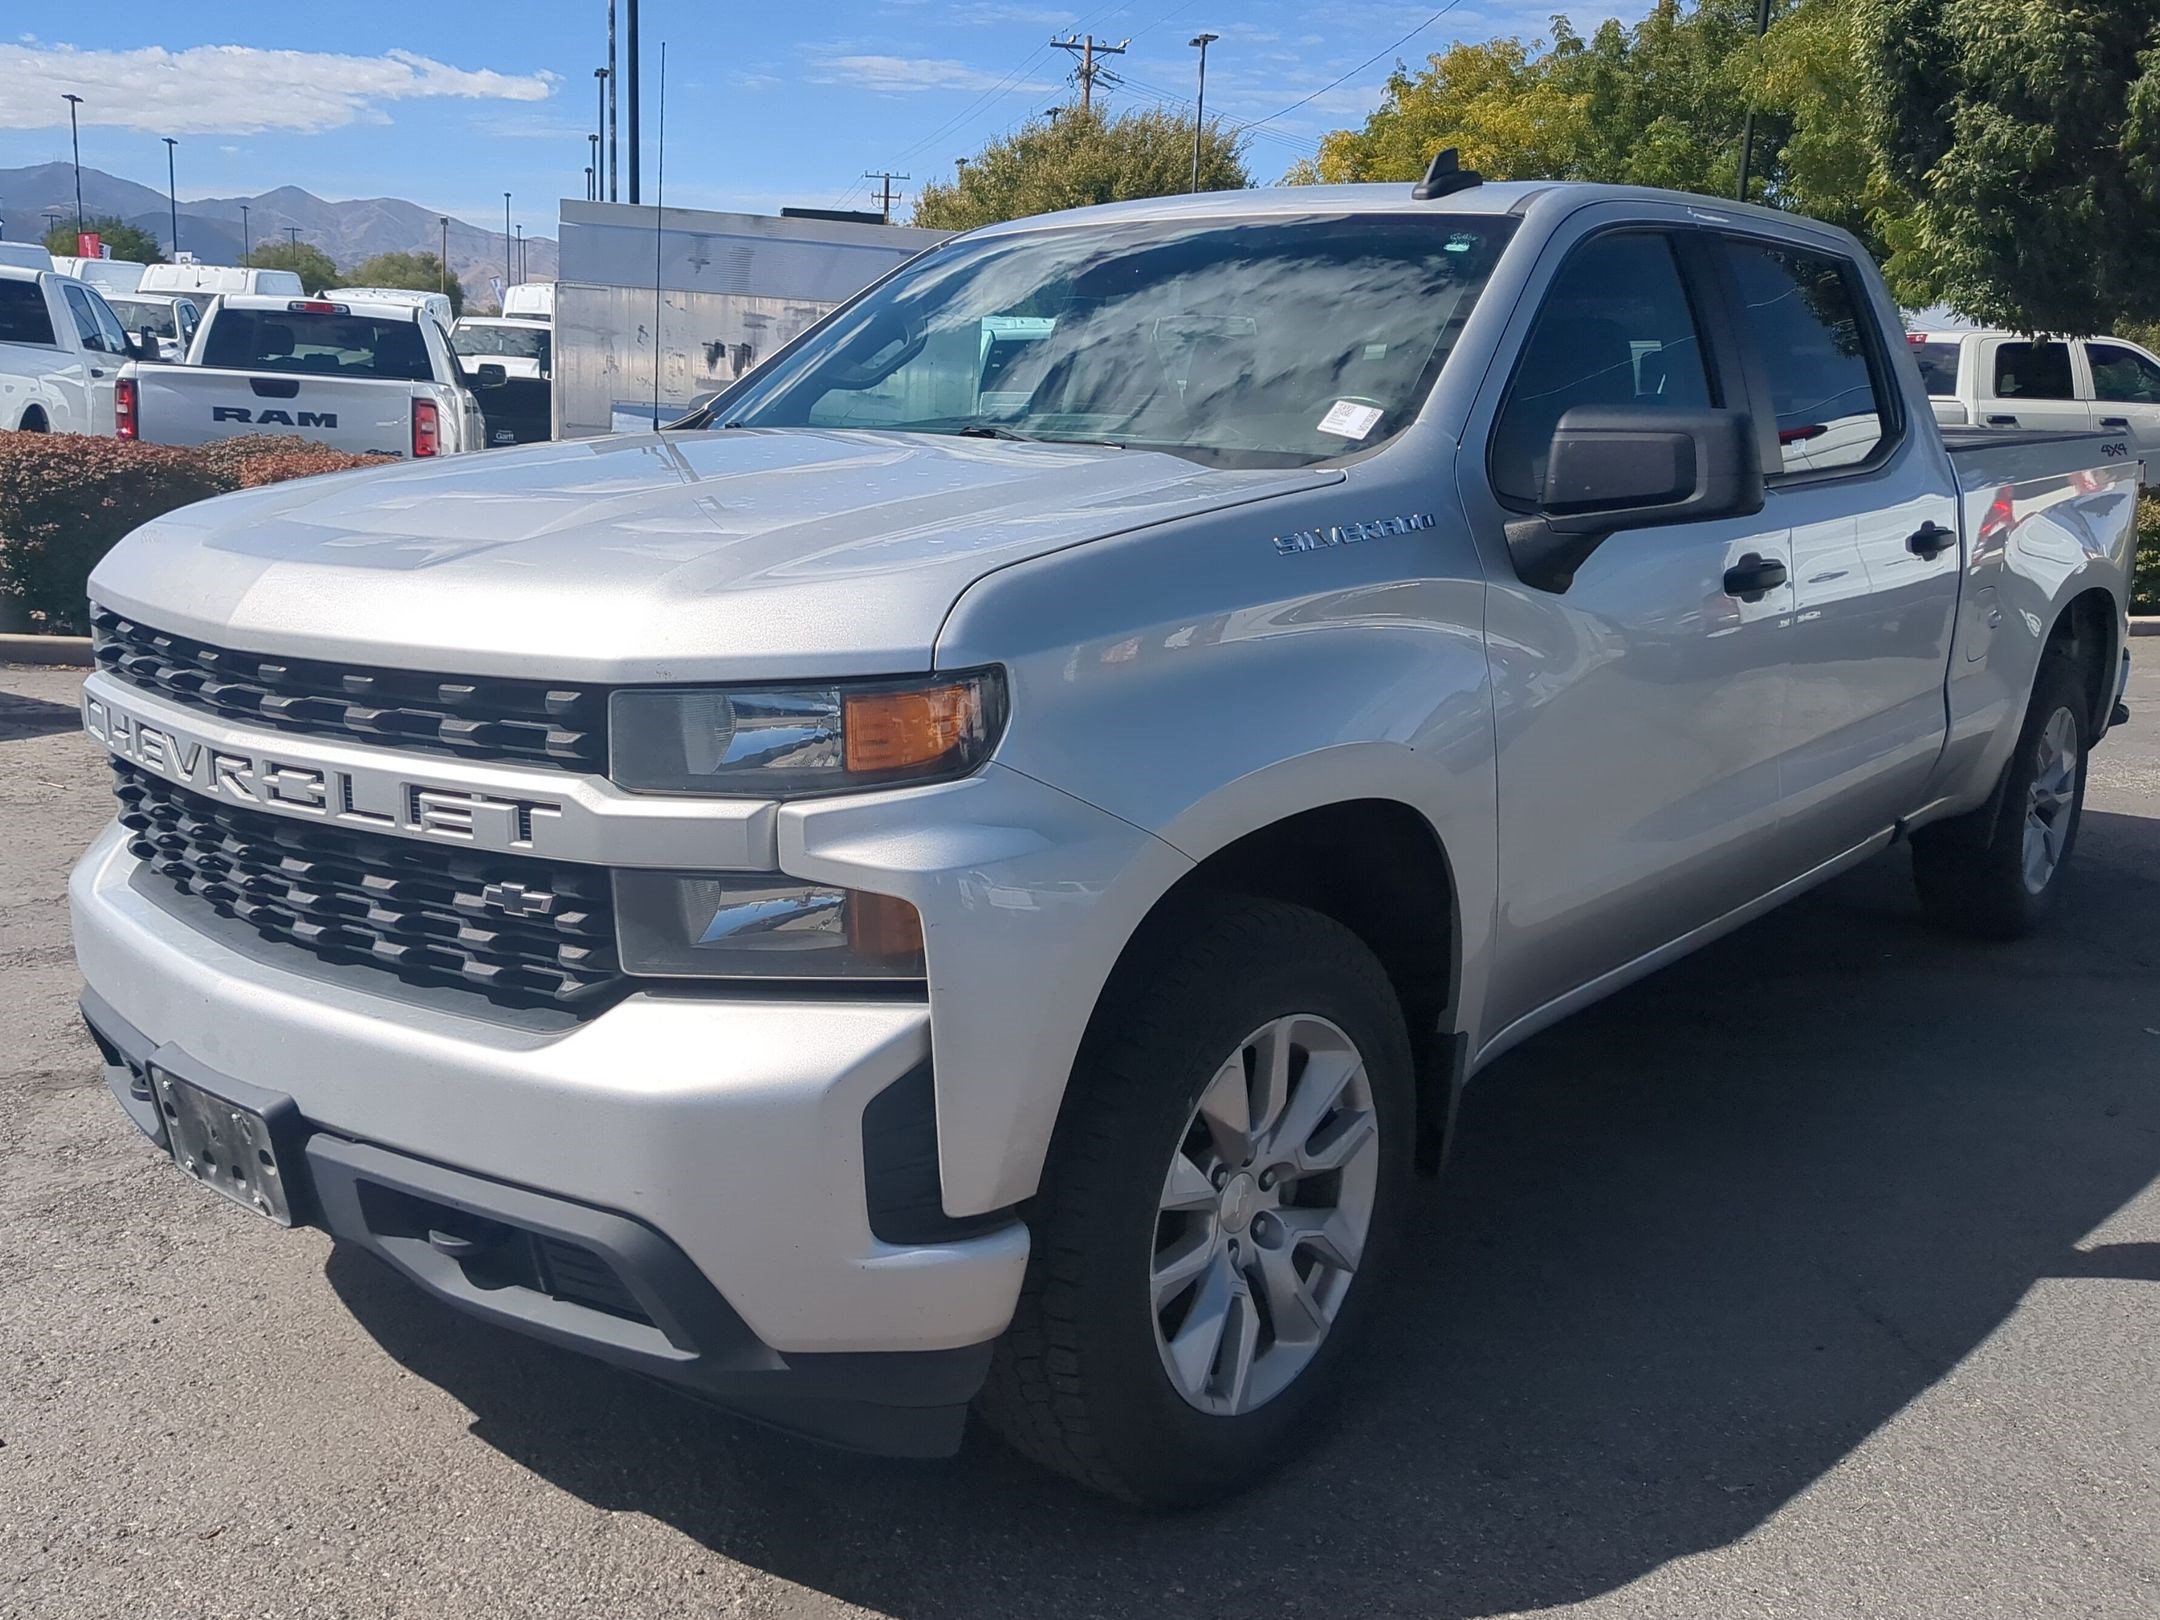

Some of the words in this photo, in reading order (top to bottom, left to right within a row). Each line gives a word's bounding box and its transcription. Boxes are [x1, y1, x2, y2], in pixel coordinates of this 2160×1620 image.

[213, 406, 338, 428] RAM
[1272, 513, 1437, 556] SILVERADO
[85, 691, 563, 848] CHEVROLET
